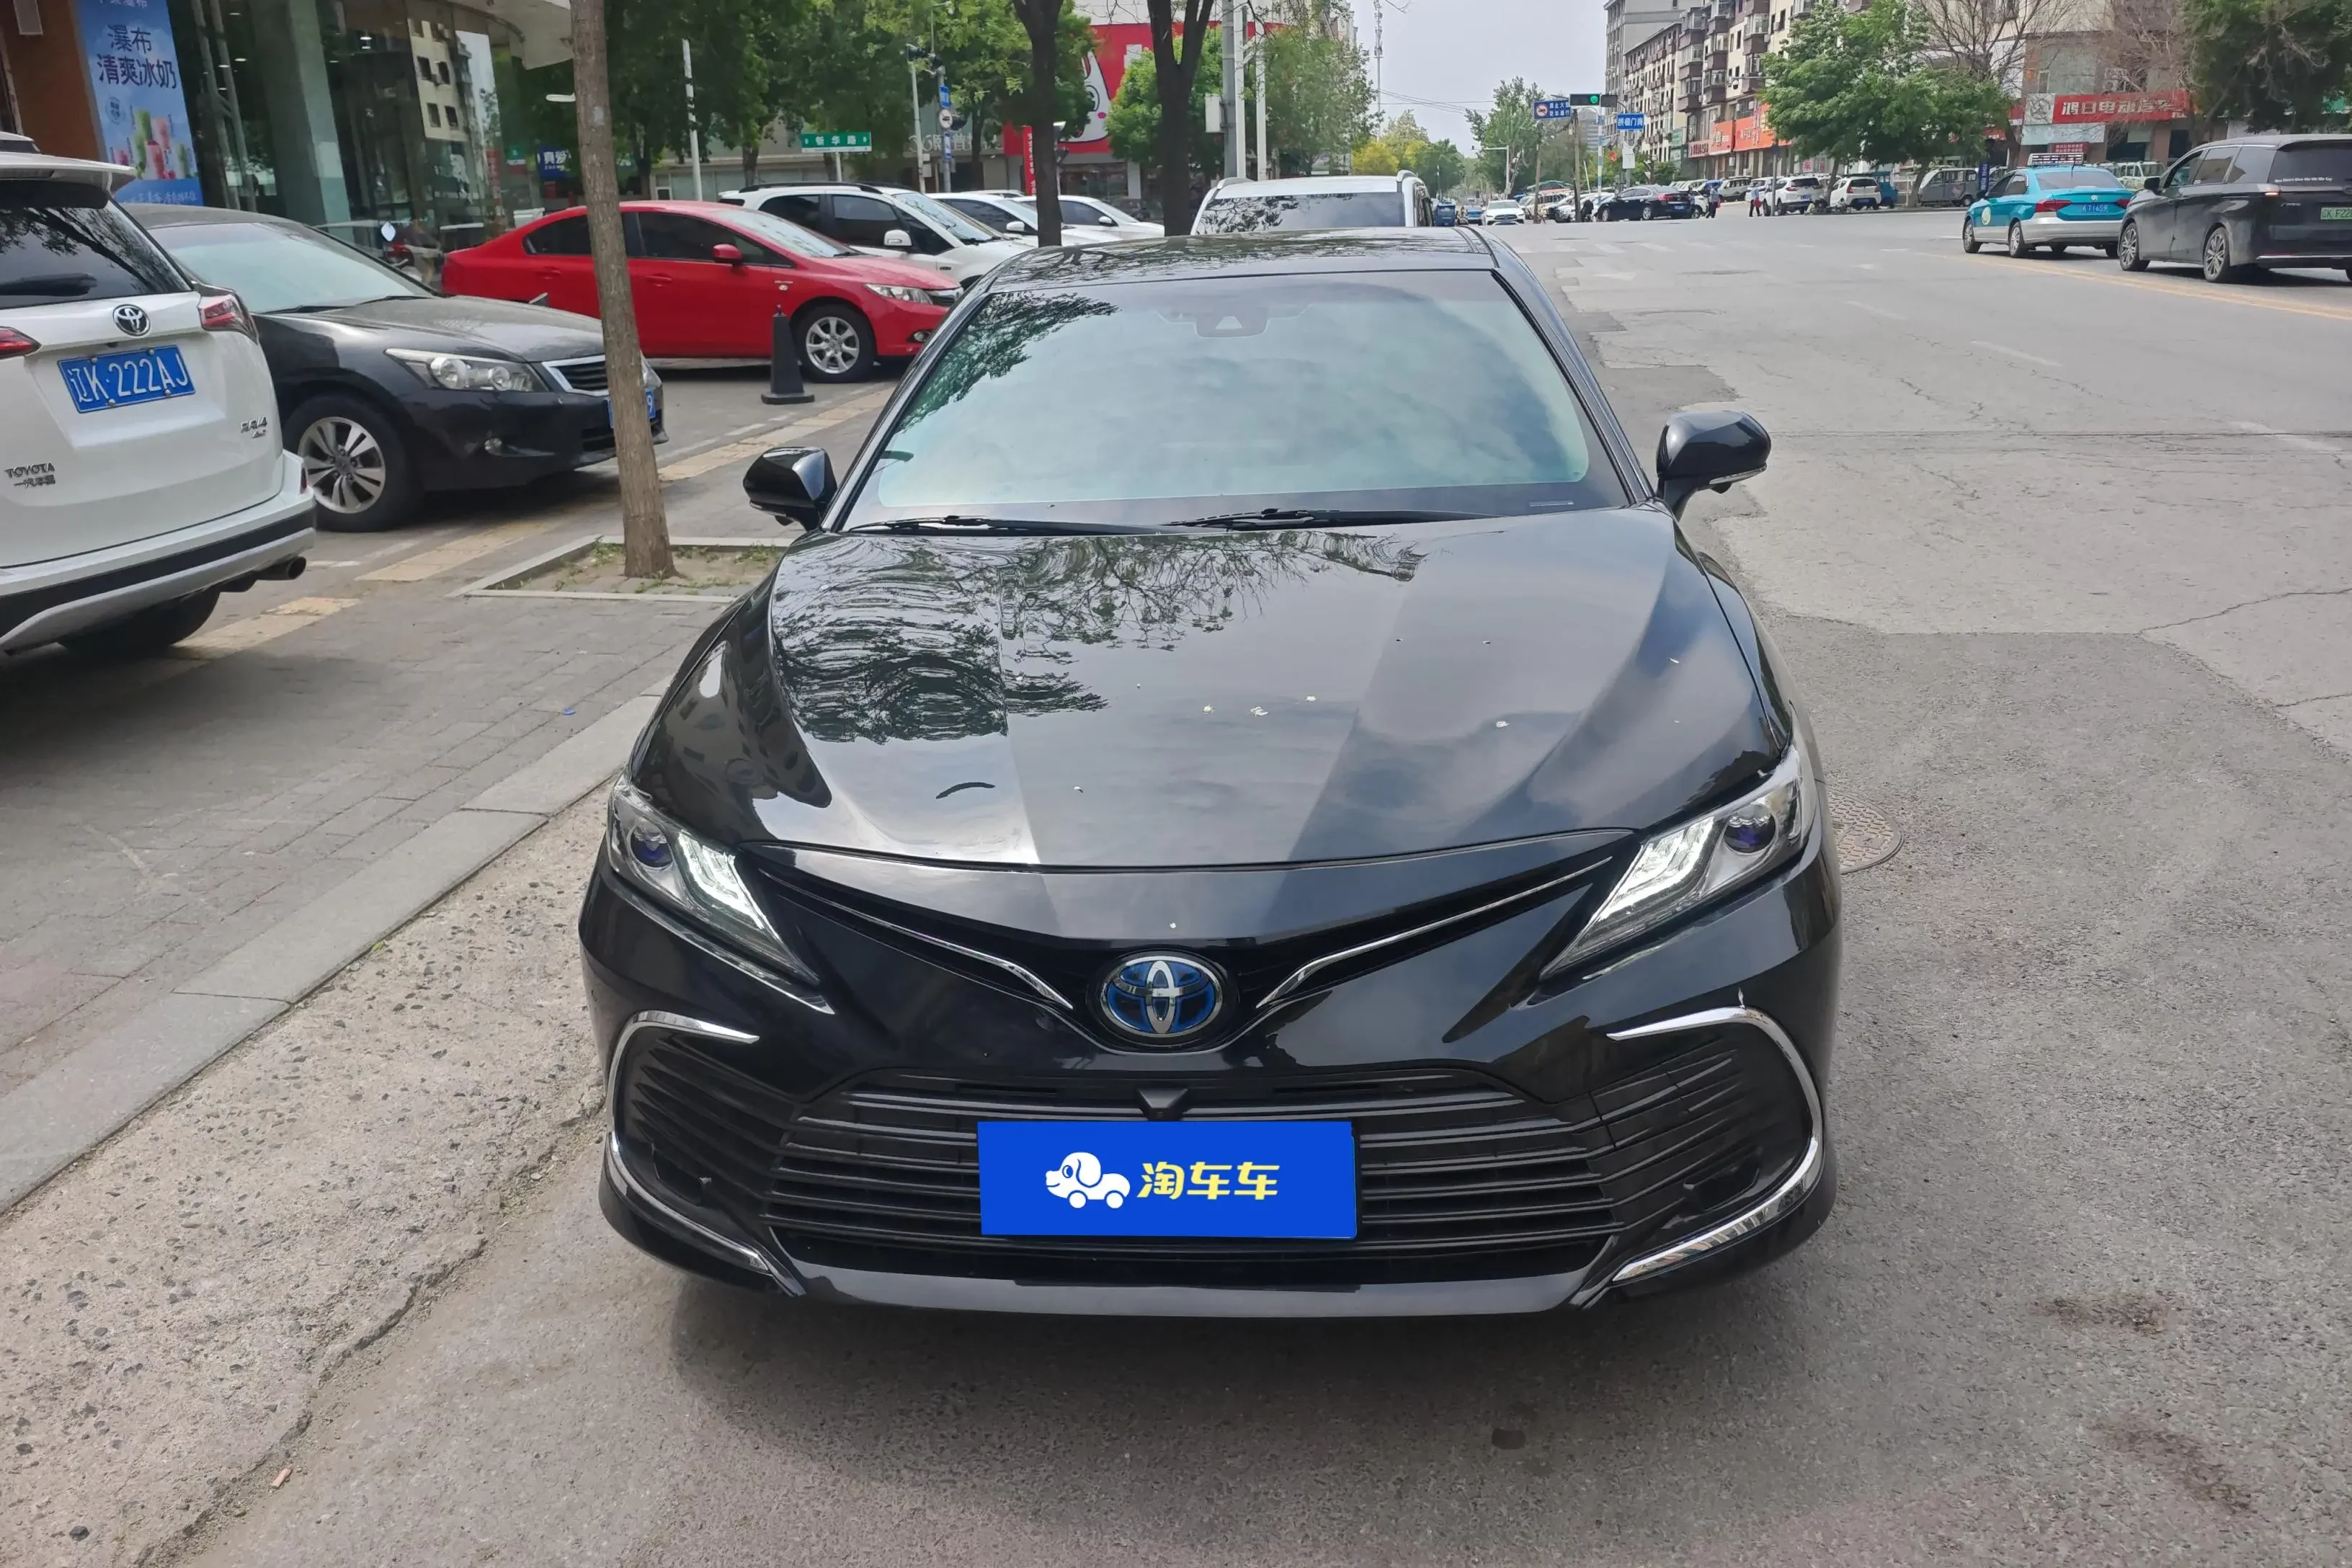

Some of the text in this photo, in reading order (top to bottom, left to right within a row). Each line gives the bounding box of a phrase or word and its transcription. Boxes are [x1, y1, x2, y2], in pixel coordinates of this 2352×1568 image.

[108, 24, 152, 53] 瀑布
[97, 54, 177, 89] 清爽冰奶
[4, 463, 55, 478] TOYOTA
